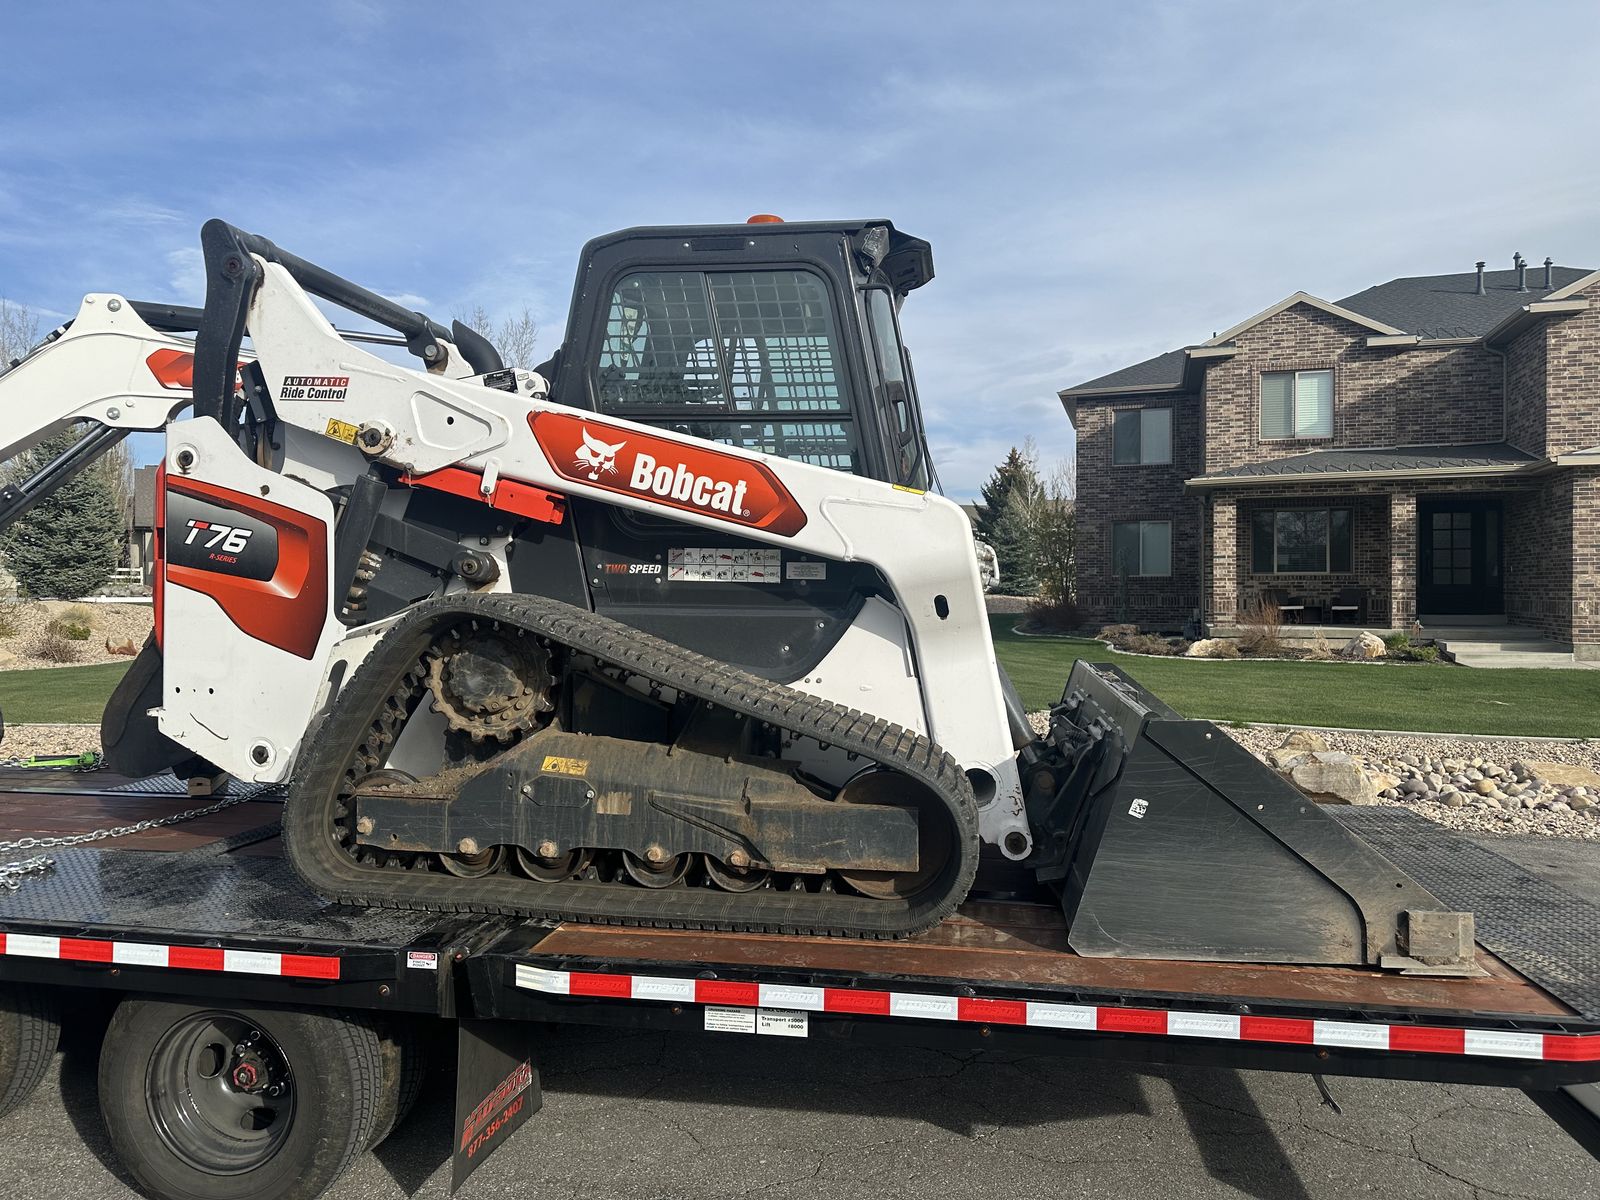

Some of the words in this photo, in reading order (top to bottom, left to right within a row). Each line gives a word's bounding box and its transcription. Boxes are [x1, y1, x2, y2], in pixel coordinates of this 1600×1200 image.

[284, 377, 348, 387] AUTOMATIC
[280, 387, 304, 399] Ride
[306, 387, 347, 400] Control
[629, 452, 748, 516] Bobcat
[184, 519, 253, 554] T76
[208, 552, 238, 564] R-SERIES
[604, 563, 627, 574] TWO
[629, 563, 662, 574] SPEED
[467, 1095, 524, 1158] 877-356-2407
